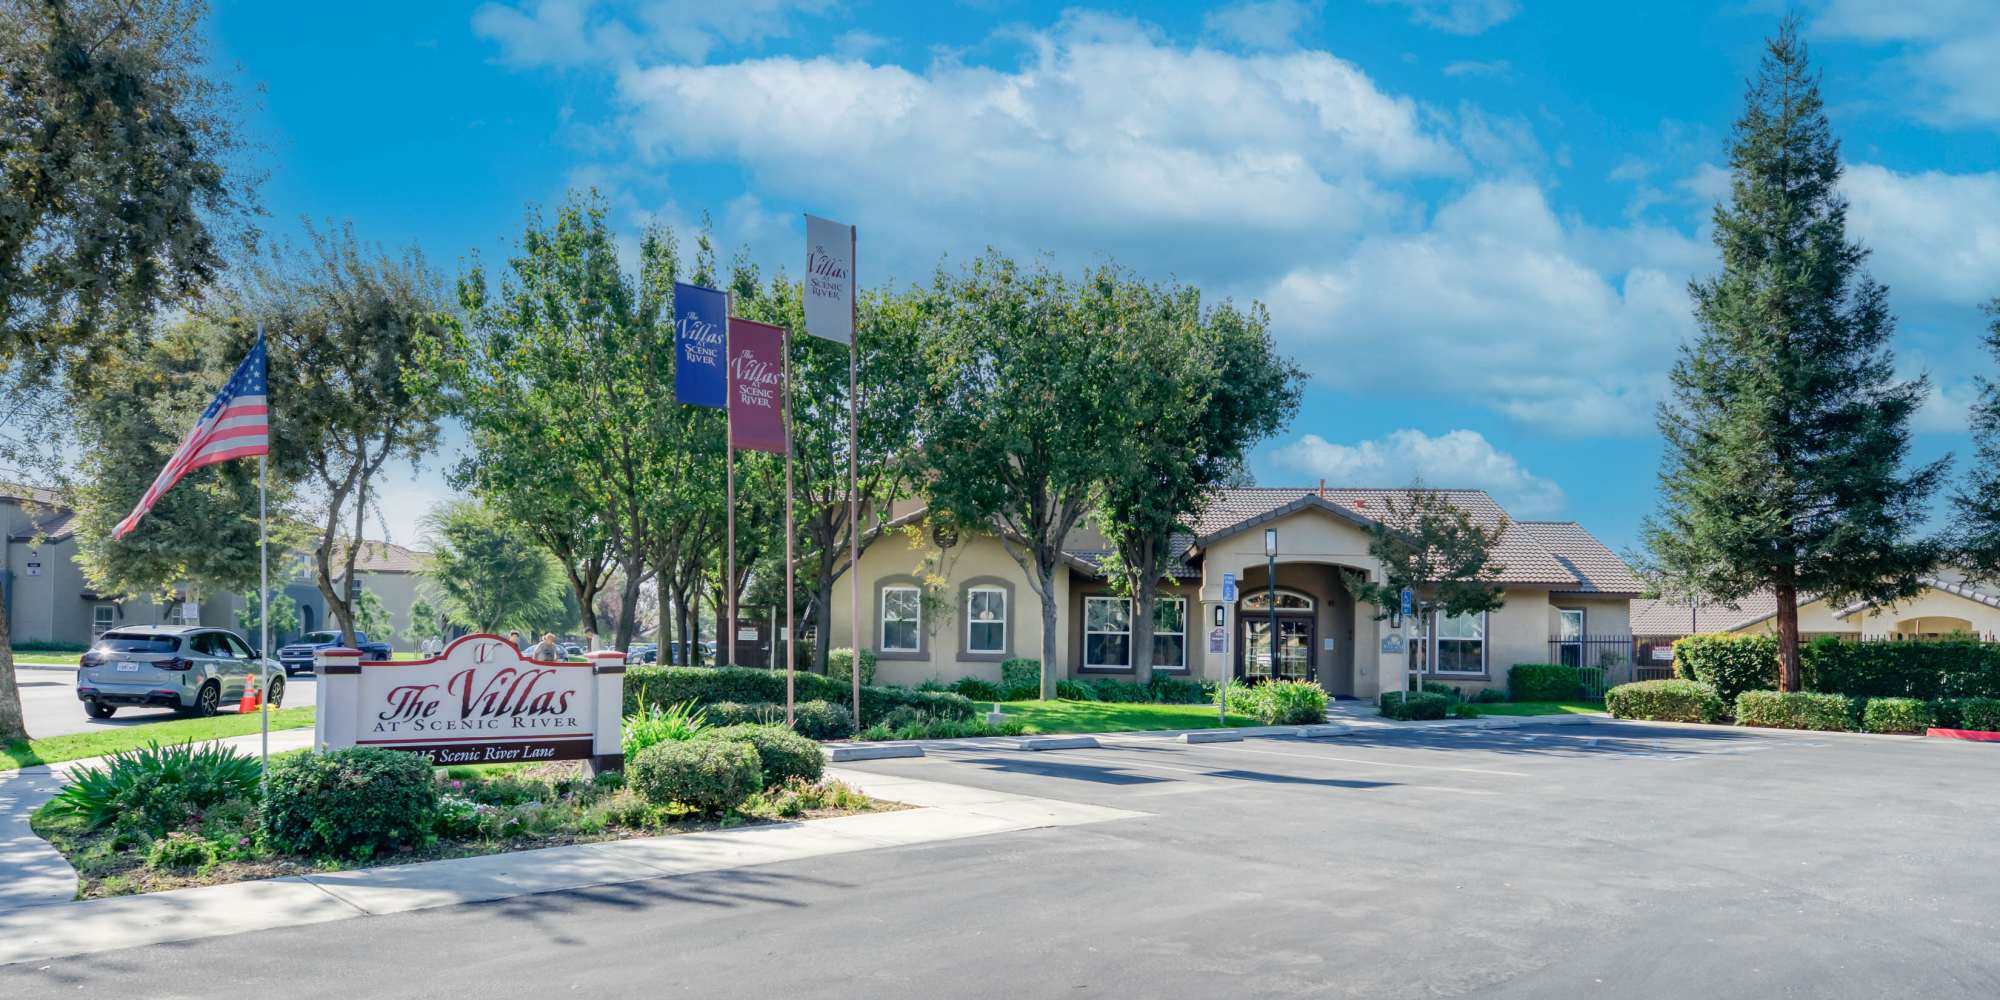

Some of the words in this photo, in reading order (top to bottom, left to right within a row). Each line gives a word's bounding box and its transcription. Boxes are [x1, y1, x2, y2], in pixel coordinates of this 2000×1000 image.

[807, 252, 849, 279] Villas
[677, 319, 724, 344] Villas
[687, 352, 716, 367] RIVER
[731, 357, 781, 385] Villas
[741, 393, 772, 409] RIVER
[378, 683, 440, 723] The
[448, 668, 576, 721] Villas
[373, 721, 400, 732] AT
[414, 718, 499, 731] SCENIC
[512, 715, 578, 729] RIVER
[439, 748, 481, 763] Scenic
[483, 746, 521, 760] River
[523, 745, 555, 758] Lane
